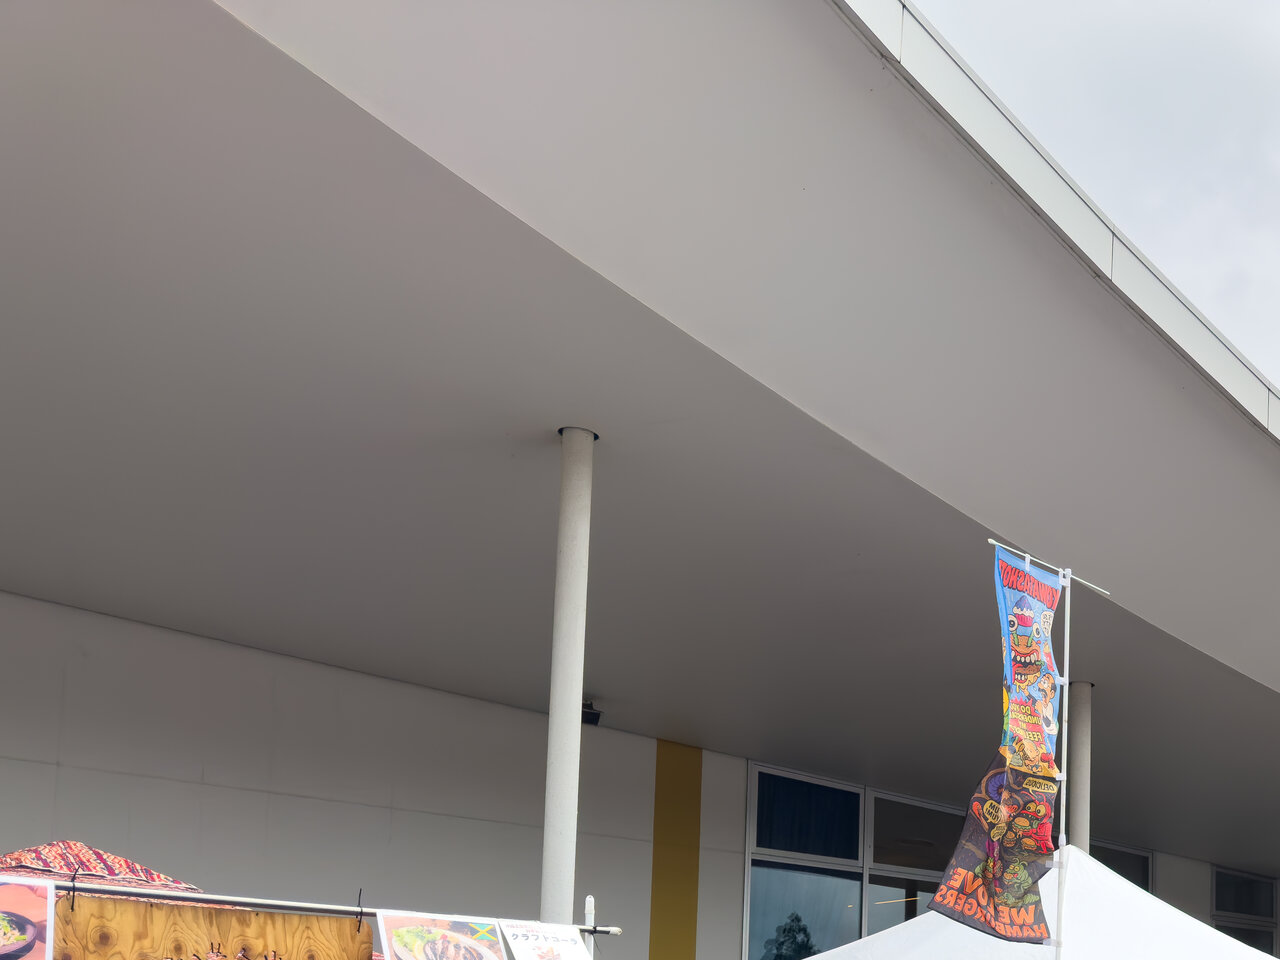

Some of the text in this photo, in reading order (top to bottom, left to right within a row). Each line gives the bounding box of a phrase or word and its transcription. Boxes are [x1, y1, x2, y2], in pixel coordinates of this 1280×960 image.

[511, 933, 578, 945] クラフトコーラ
